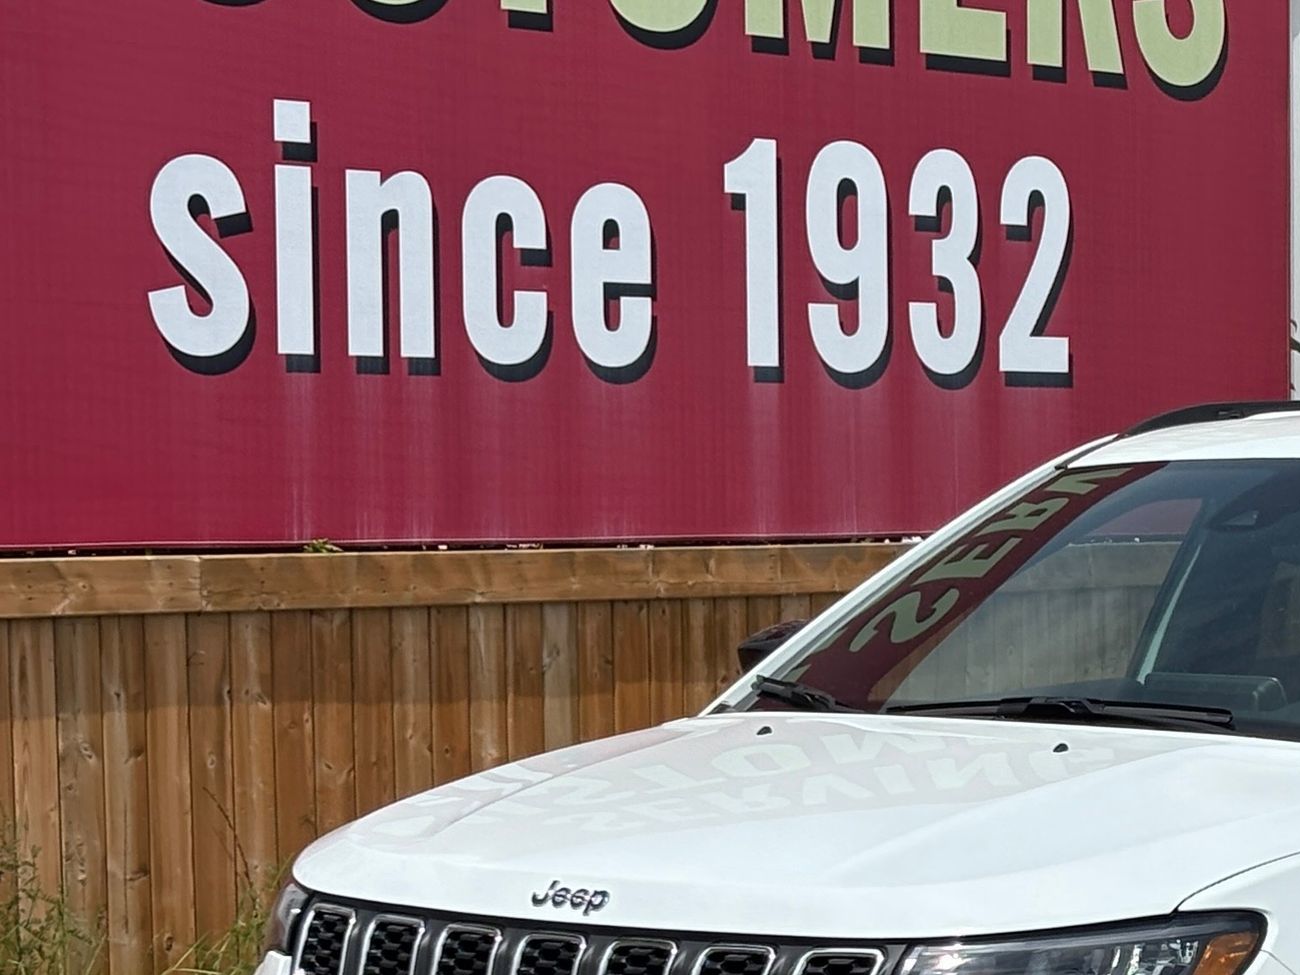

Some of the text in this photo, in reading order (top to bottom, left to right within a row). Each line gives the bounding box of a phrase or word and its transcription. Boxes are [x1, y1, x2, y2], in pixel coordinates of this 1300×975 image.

[147, 99, 1073, 386] since 1932
[531, 880, 610, 917] Jeep
